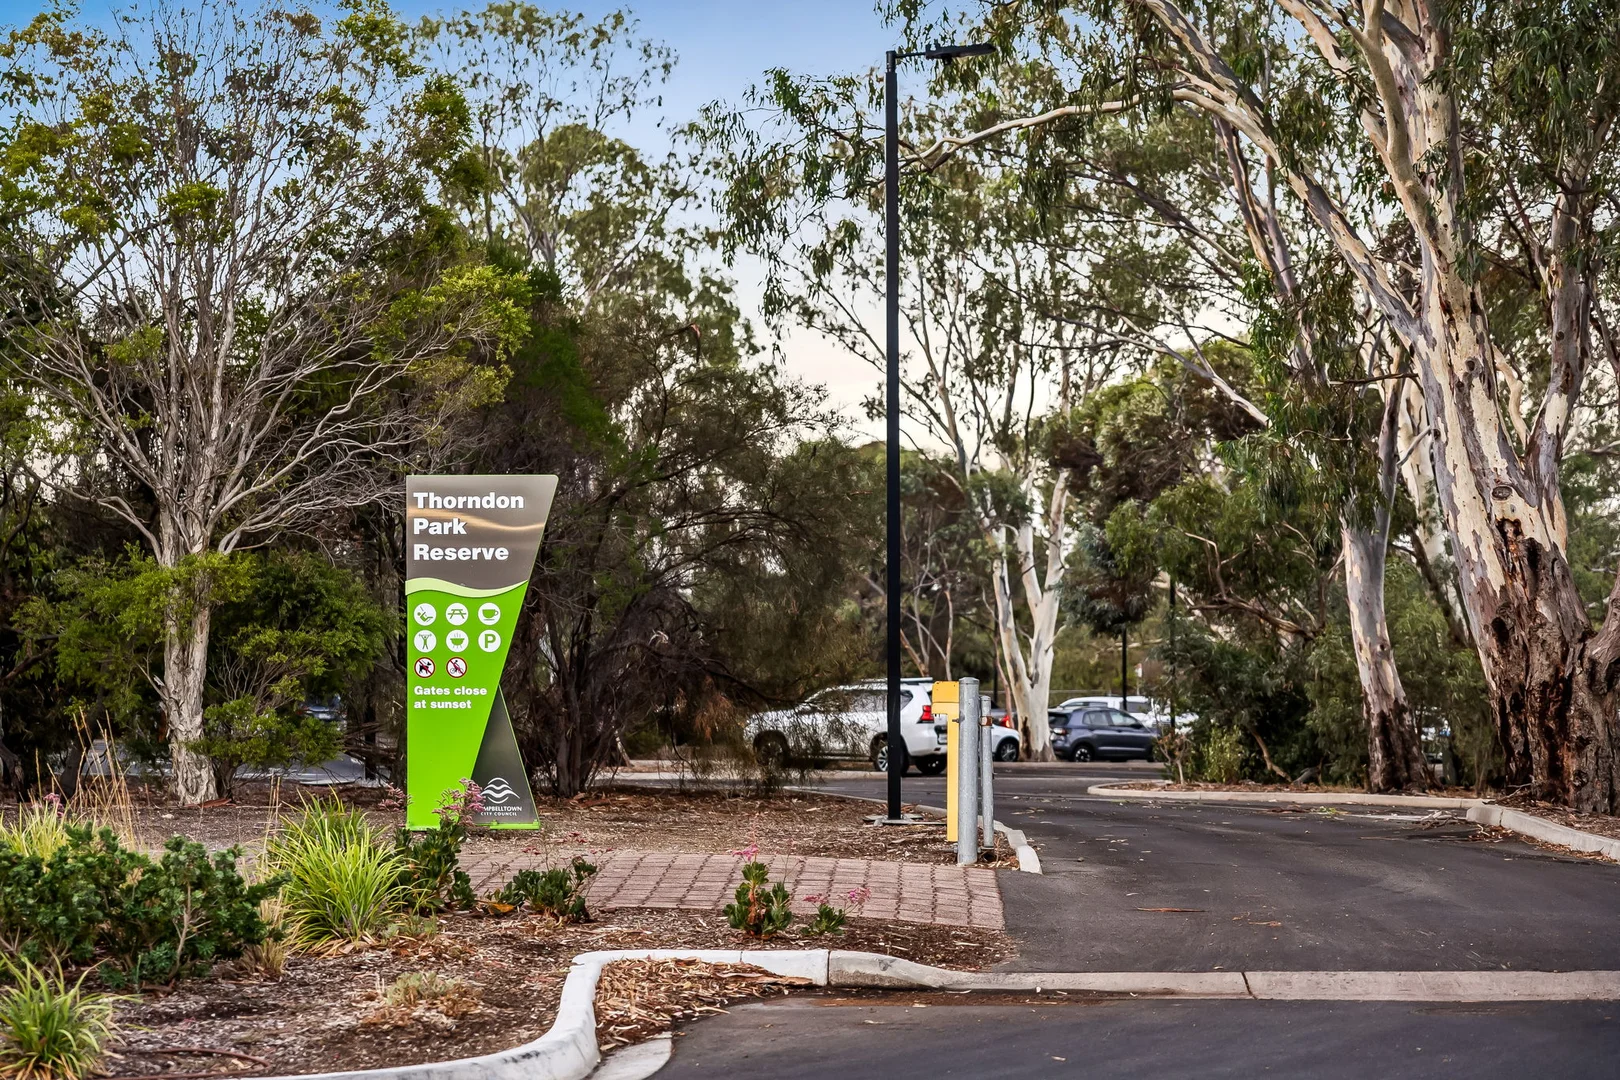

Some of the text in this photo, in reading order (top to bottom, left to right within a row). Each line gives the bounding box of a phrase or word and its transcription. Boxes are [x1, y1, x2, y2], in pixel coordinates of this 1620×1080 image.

[413, 492, 524, 509] Thorndon
[413, 518, 467, 535] Park
[413, 544, 509, 561] Reserve
[484, 634, 496, 648] P
[414, 686, 487, 695] Gates close
[414, 700, 472, 708] at sunset
